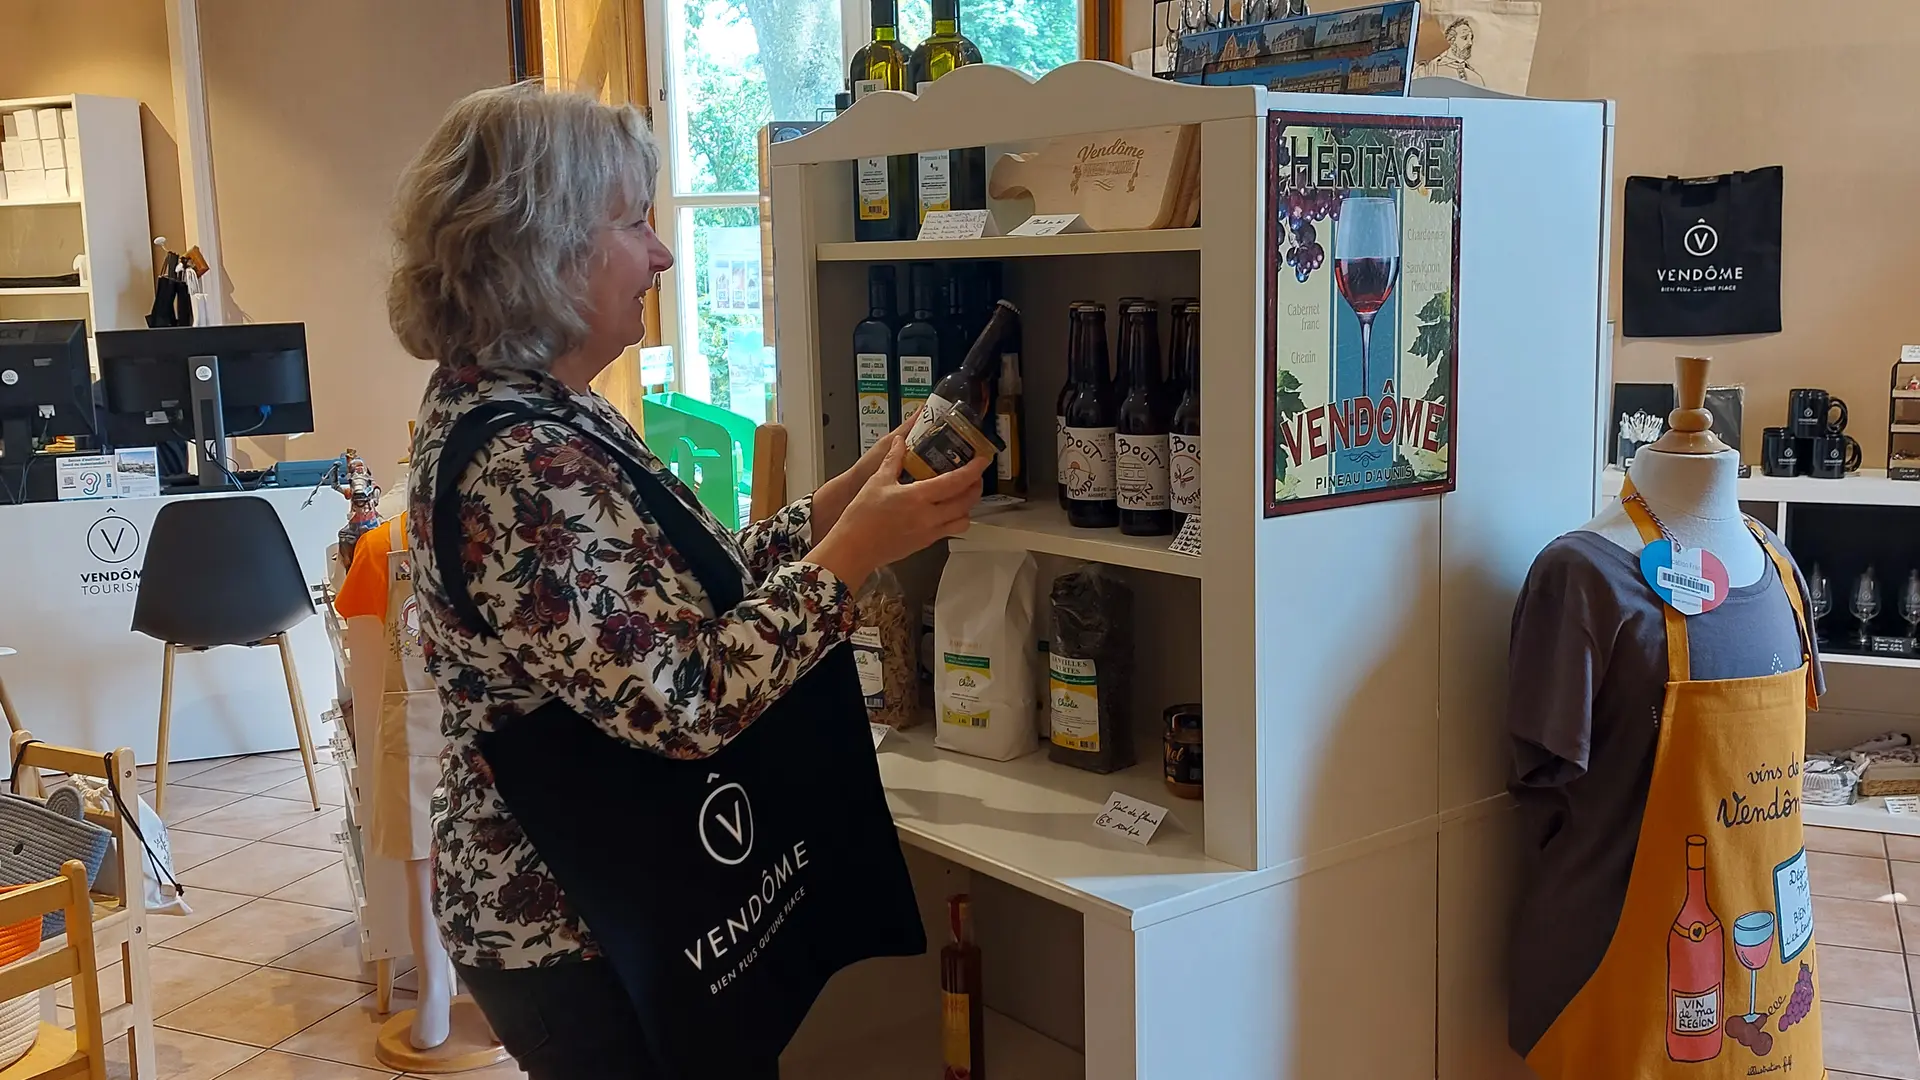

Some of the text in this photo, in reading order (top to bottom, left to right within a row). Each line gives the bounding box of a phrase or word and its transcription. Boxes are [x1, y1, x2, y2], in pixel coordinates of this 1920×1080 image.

[1077, 137, 1144, 162] Vendôme
[1290, 130, 1445, 189] HÉRITAGE
[1657, 264, 1744, 281] VENDÔME
[1287, 303, 1320, 316] Cabernet
[1291, 350, 1316, 364] Chenin
[1280, 379, 1446, 468] VENDÔME
[1315, 465, 1414, 489] PINEAU D'AUNIS
[80, 567, 141, 583] VENDÔM
[395, 572, 411, 581] Les
[81, 582, 140, 595] TOURIS
[1747, 763, 1782, 784] vins
[684, 840, 809, 971] VENDÔME
[710, 886, 806, 995] BIEN PLUS QU'UNE PLACE
[1683, 998, 1705, 1009] VIN
[1678, 1007, 1715, 1019] de ma
